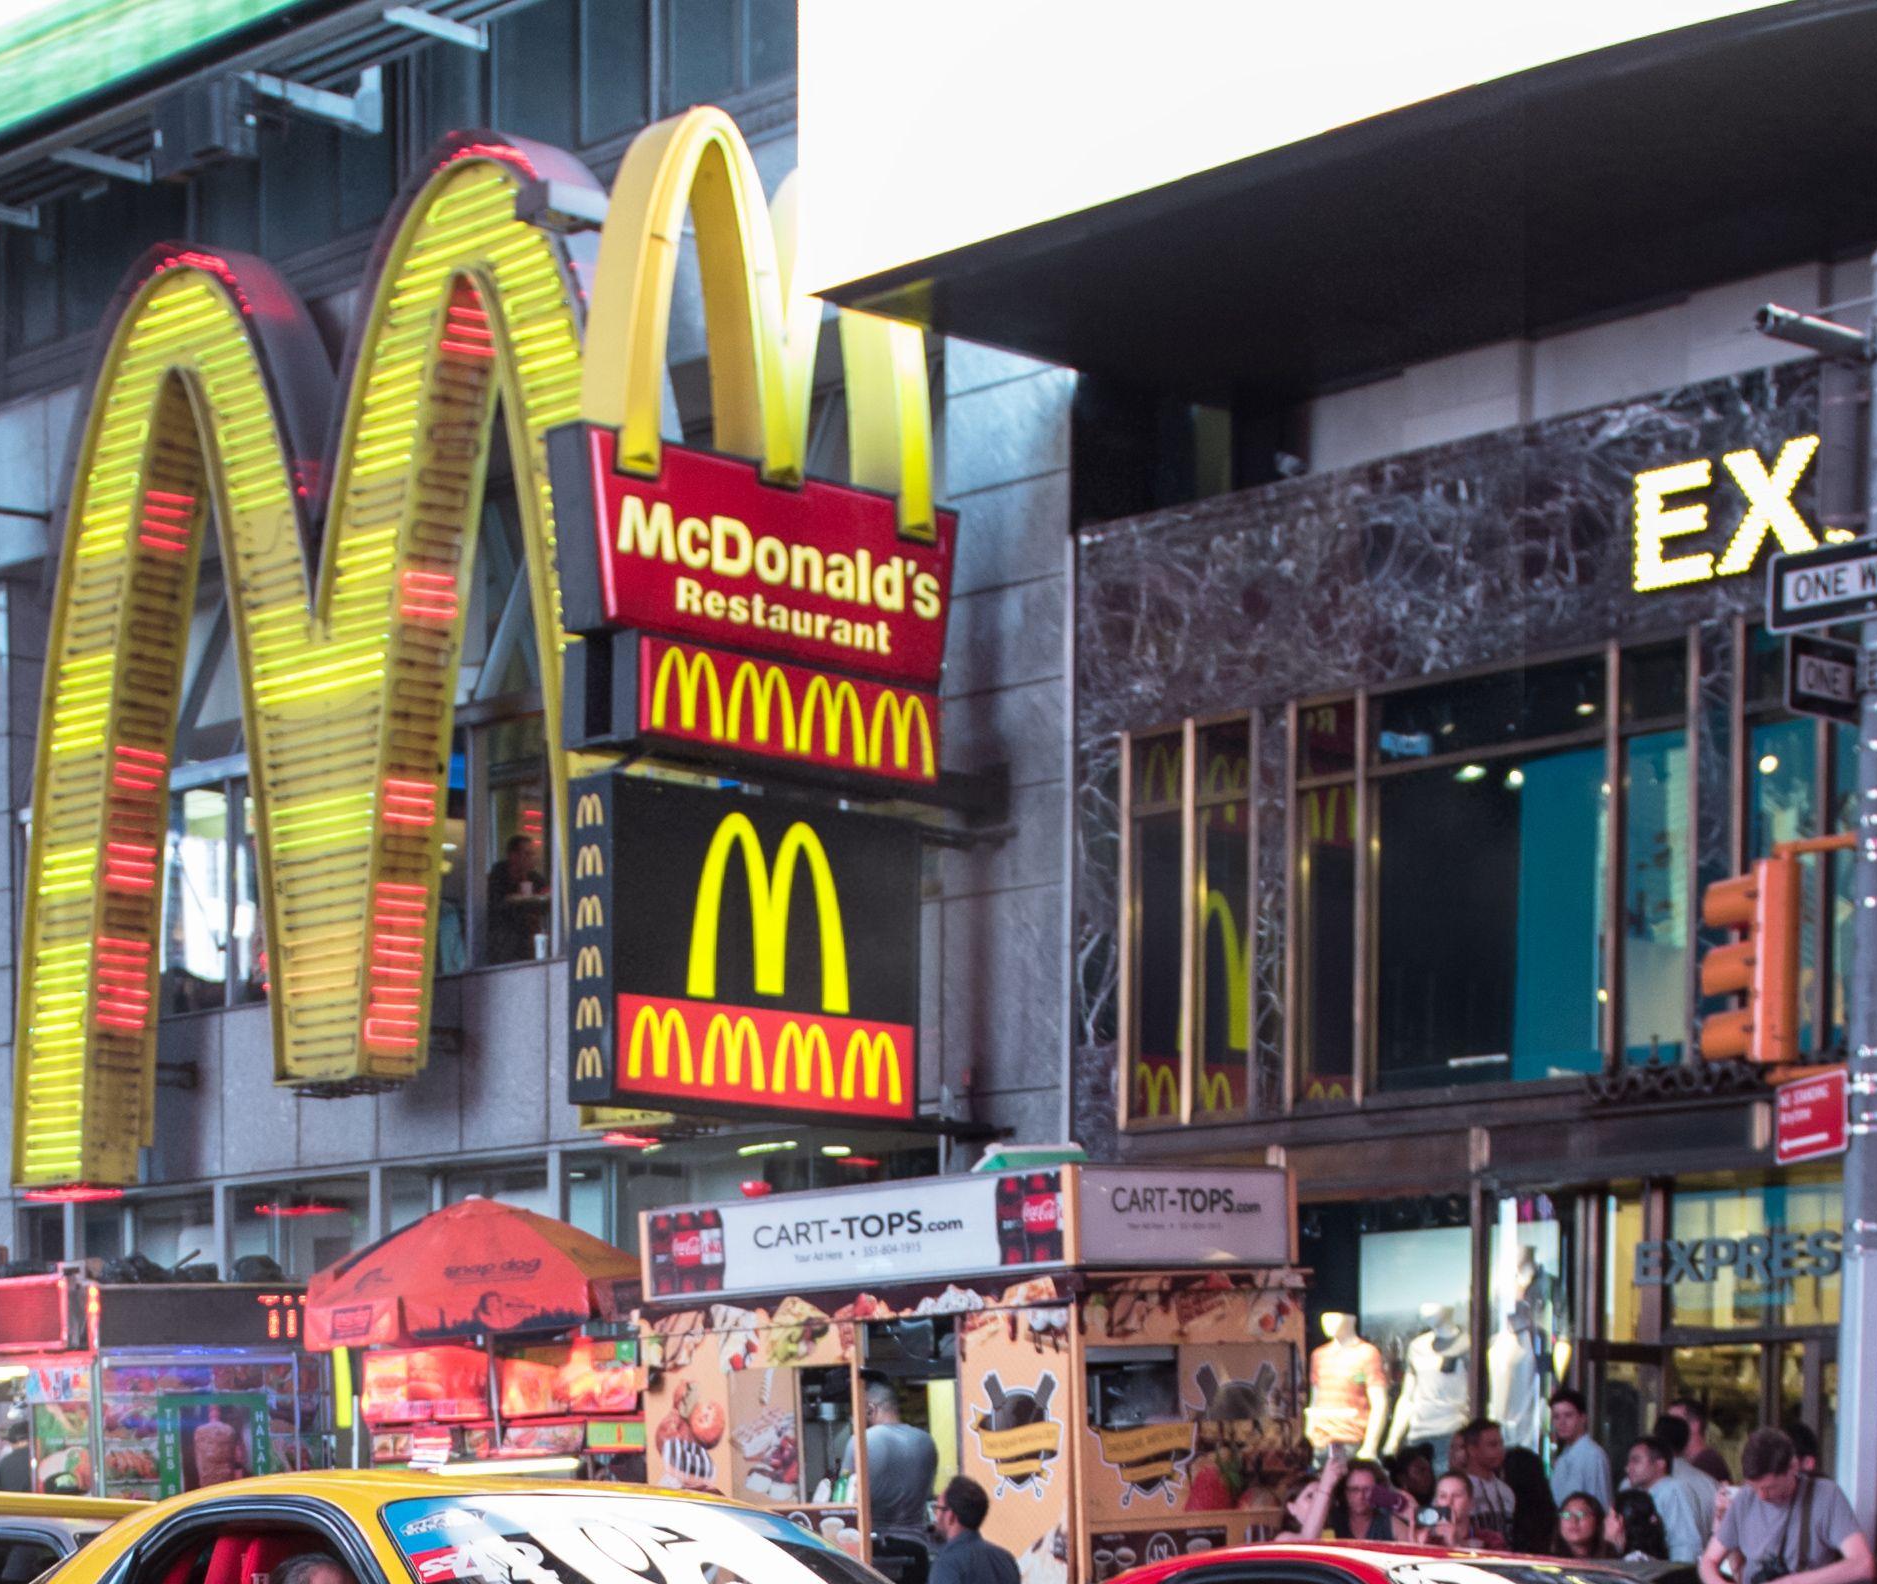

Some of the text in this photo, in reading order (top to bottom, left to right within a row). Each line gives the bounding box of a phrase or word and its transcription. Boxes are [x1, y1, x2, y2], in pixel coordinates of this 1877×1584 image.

[617, 494, 941, 620] McDonald's
[1792, 566, 1849, 604] ONE
[675, 575, 892, 656] Restaurant
[1803, 660, 1845, 698] ONE
[1111, 1186, 1262, 1214] CART-TOPS.com
[753, 1209, 964, 1250] CART-TOPS.com
[1633, 1229, 1842, 1288] EXPRES
